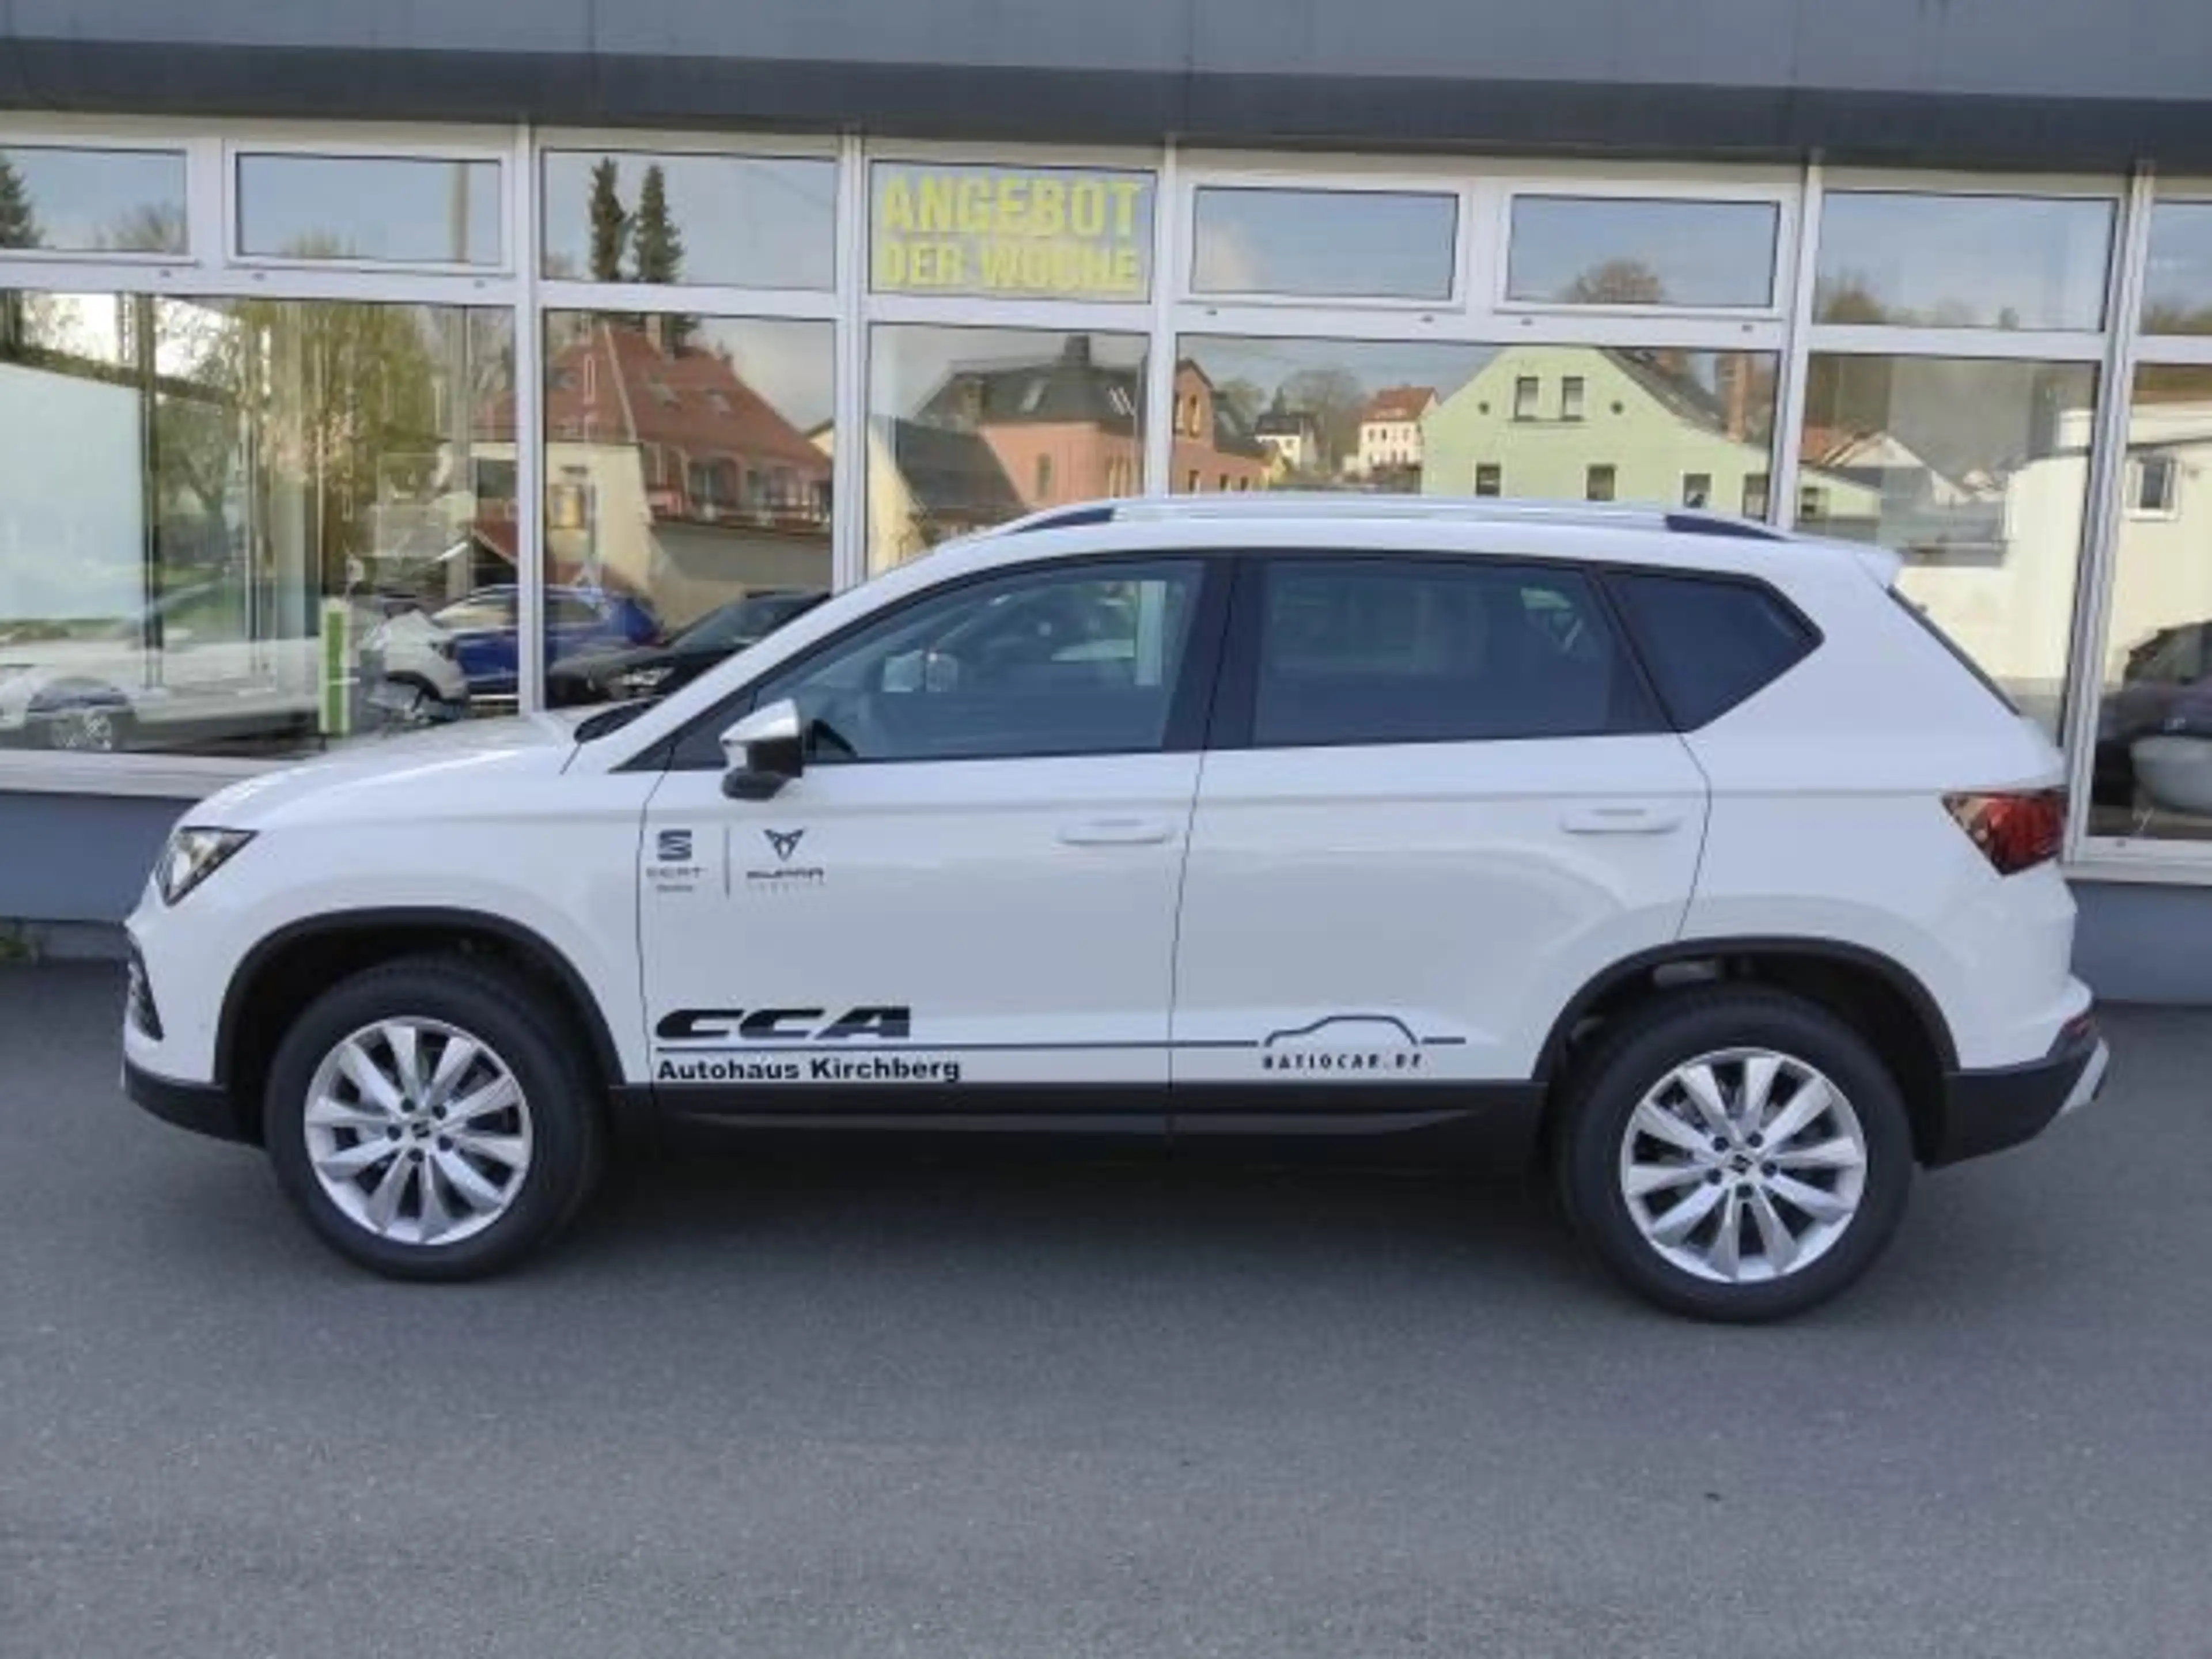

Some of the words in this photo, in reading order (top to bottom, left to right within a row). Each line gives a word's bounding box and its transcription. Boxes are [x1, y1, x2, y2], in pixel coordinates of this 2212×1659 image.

[882, 176, 1141, 237] ANGEBOT
[882, 240, 966, 286] DER
[656, 1006, 910, 1040] CCA
[658, 1059, 800, 1081] Autohaus
[810, 1058, 961, 1084] Kirchberg
